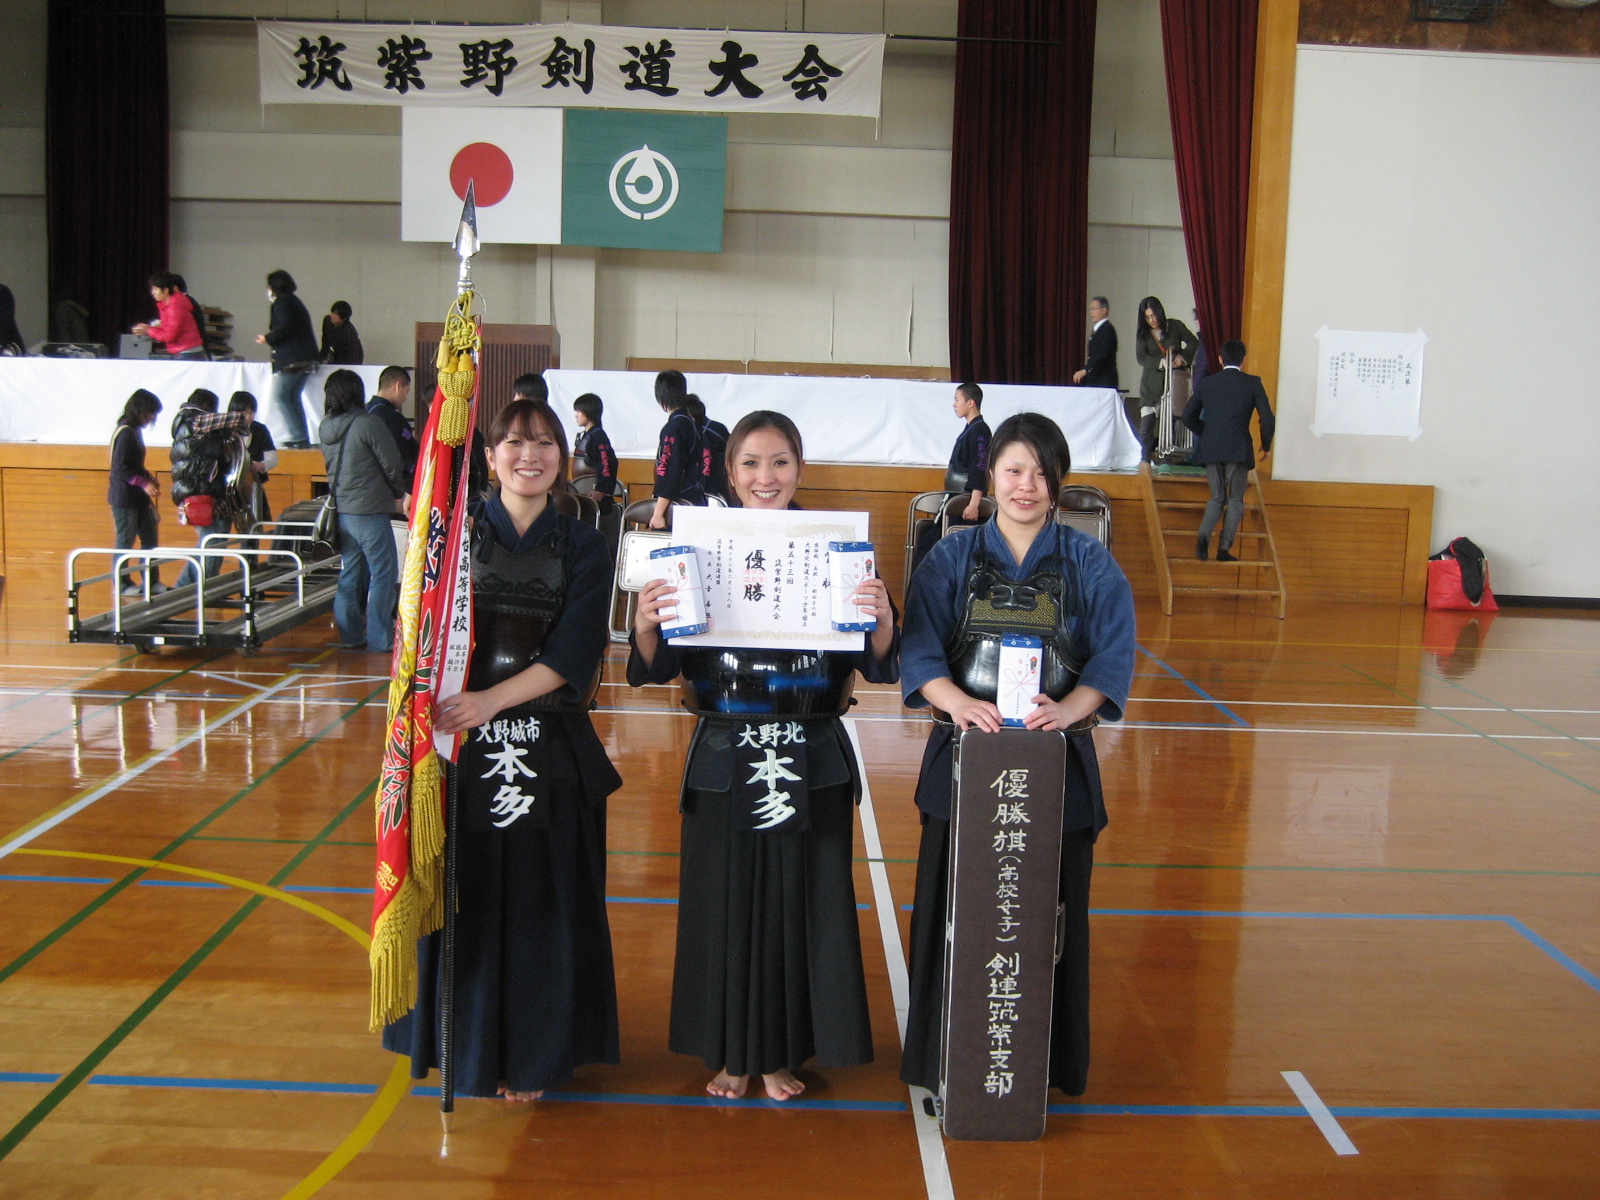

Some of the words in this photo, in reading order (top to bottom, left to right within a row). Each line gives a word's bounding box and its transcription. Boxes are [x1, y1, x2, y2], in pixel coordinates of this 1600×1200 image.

[293, 35, 843, 101] 筑紫野剣道大会
[743, 549, 766, 602] 優勝
[787, 541, 795, 585] 第五十三回
[475, 717, 541, 744] 大野城市
[737, 721, 806, 748] 大野北
[480, 743, 538, 828] 本多
[745, 749, 803, 830] 本多
